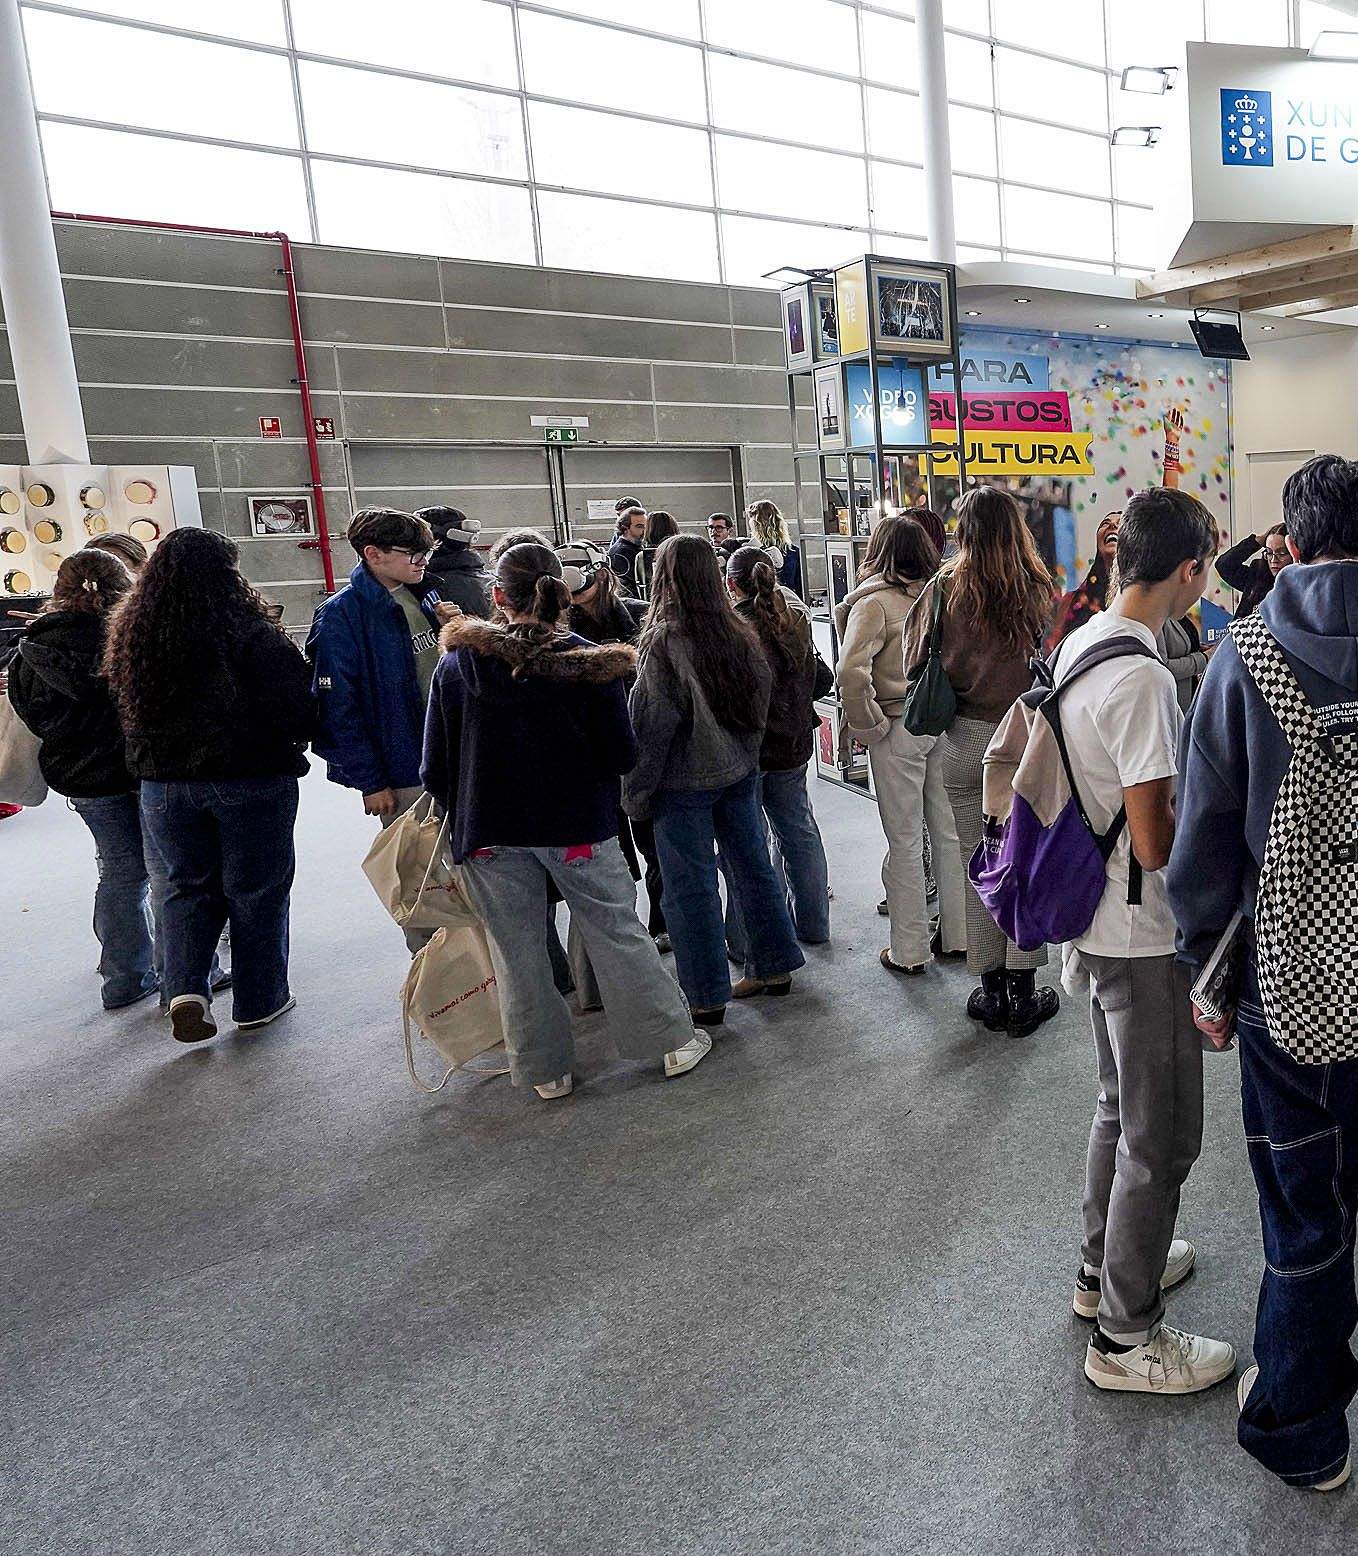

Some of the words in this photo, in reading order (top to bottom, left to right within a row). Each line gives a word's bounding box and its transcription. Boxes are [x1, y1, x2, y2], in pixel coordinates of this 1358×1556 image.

[1286, 135, 1327, 162] DE
[935, 357, 1033, 385] PARA
[862, 388, 917, 406] VDO
[929, 398, 1069, 428] GUSTOS,
[930, 441, 1081, 465] CULTURA
[1313, 703, 1339, 714] UTSIDE
[1340, 701, 1358, 710] YOUR
[1332, 708, 1358, 717] FOLLOW
[1341, 716, 1354, 724] TRY
